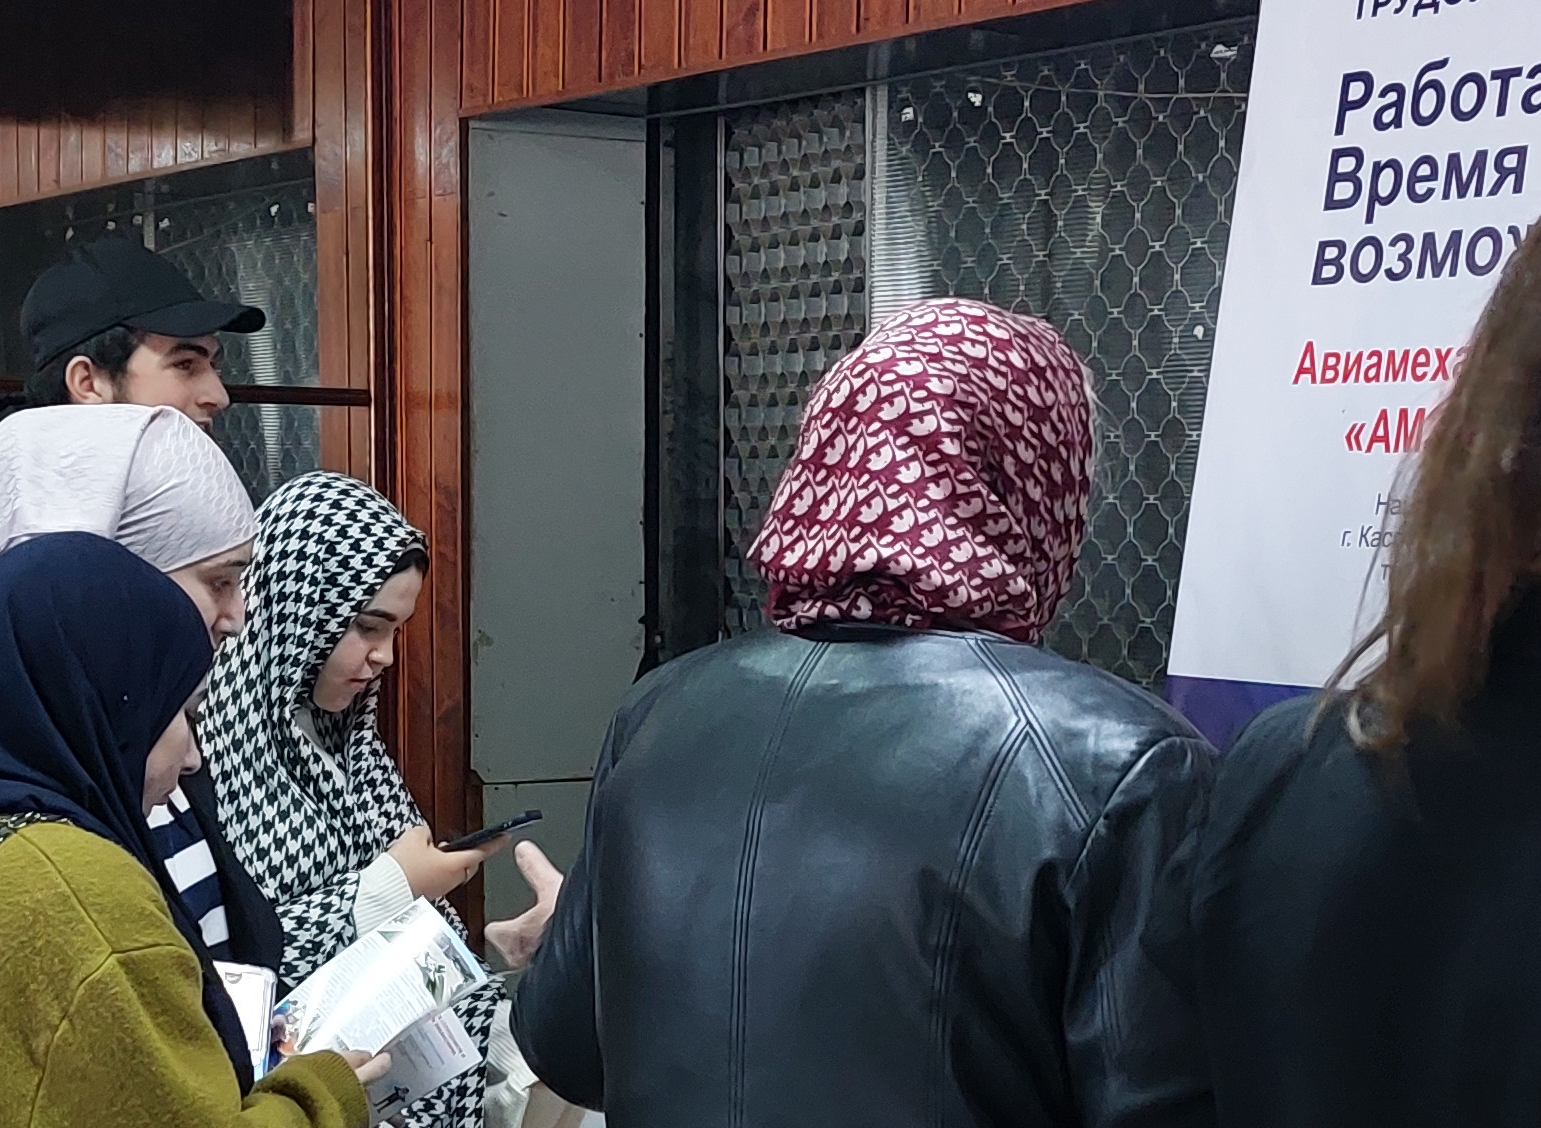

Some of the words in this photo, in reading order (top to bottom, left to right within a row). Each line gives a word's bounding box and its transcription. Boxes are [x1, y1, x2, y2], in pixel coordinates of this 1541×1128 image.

[1323, 145, 1529, 225] Время
[1374, 493, 1405, 516] На
[1340, 529, 1352, 547] г.
